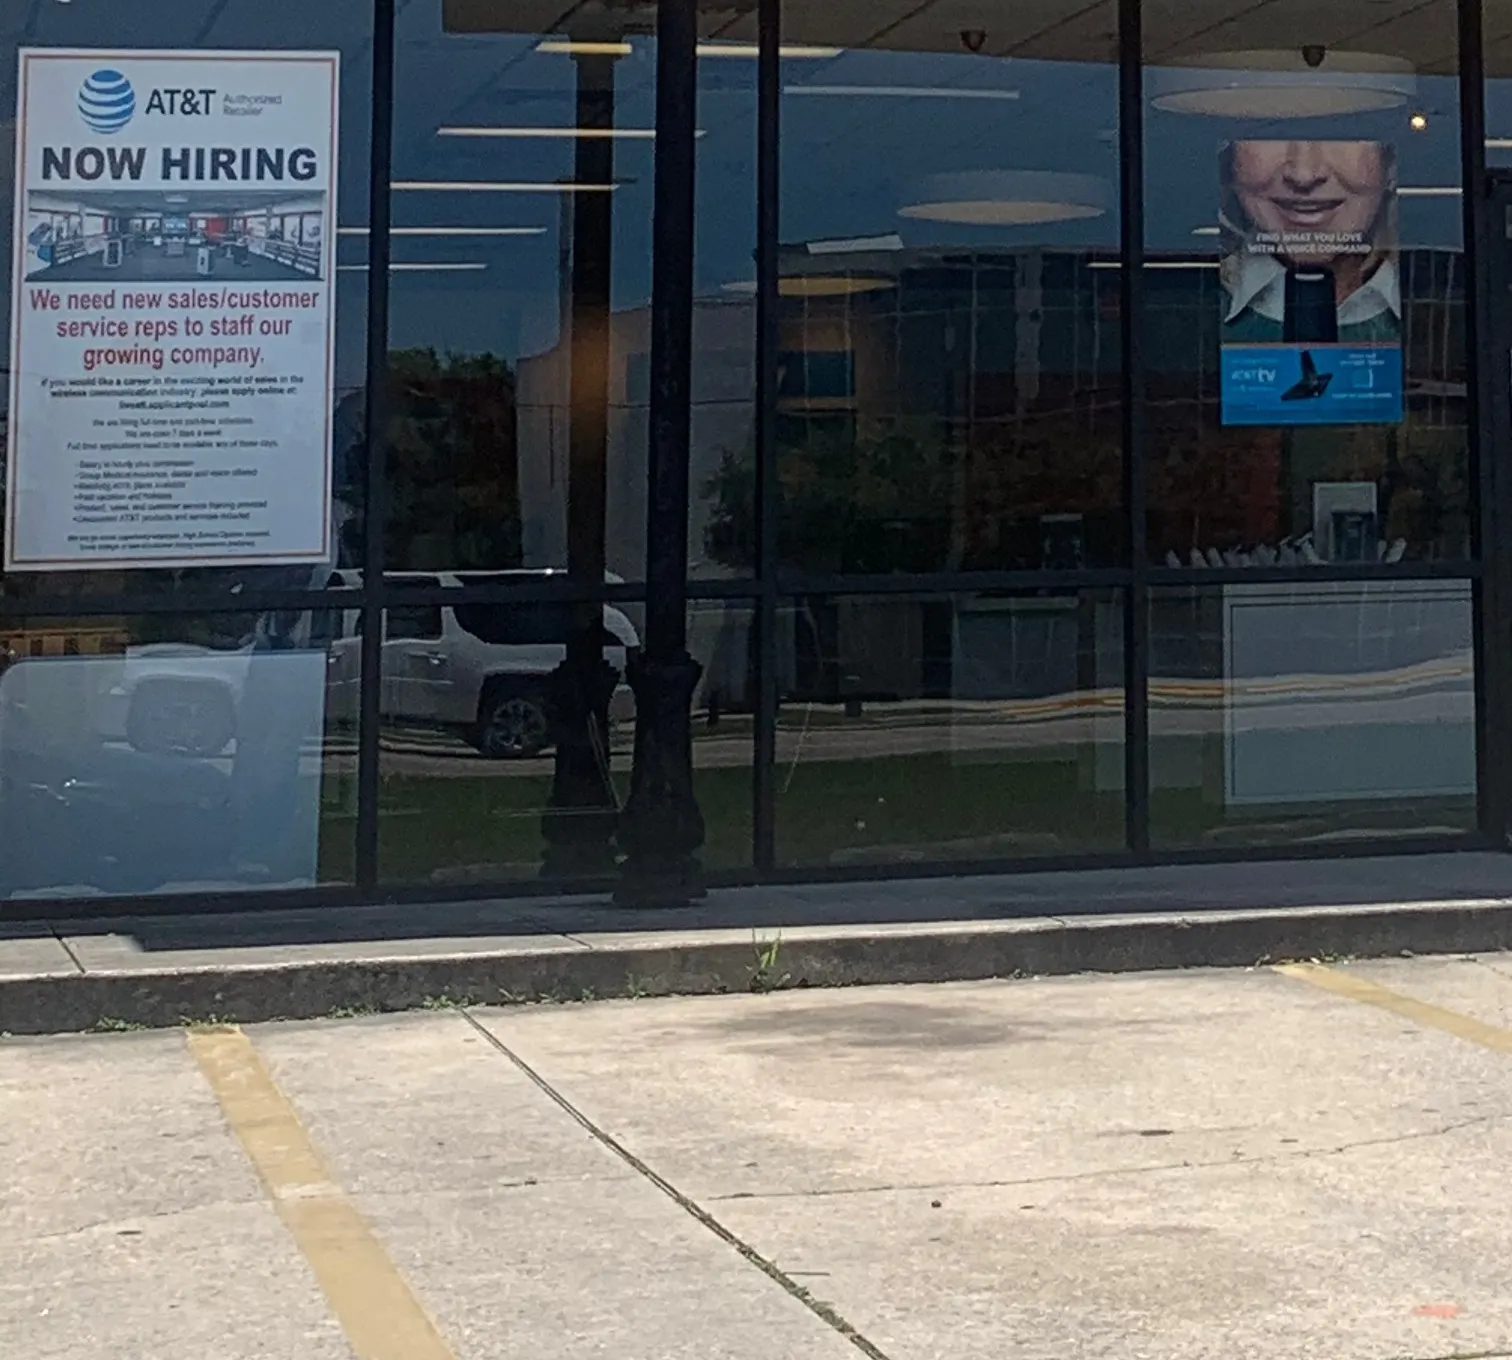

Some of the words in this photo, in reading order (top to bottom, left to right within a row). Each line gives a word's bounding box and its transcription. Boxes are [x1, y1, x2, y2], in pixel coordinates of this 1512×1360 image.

[145, 88, 216, 115] AT&T
[41, 147, 147, 180] NOW
[161, 147, 317, 181] HIRING
[1247, 243, 1275, 253] WITH
[1277, 244, 1285, 253] A
[1283, 233, 1311, 242] WHAT
[1314, 233, 1335, 242] YOU
[1337, 232, 1363, 242] LOVE
[30, 289, 60, 310] We
[67, 289, 115, 309] need
[122, 293, 163, 309] new
[168, 287, 320, 309] sales/customer
[57, 316, 129, 337] service
[135, 319, 178, 341] reps
[184, 317, 204, 336] to
[210, 315, 256, 336] staff
[260, 319, 292, 336] our
[84, 344, 164, 370] growing
[171, 346, 265, 368] company.
